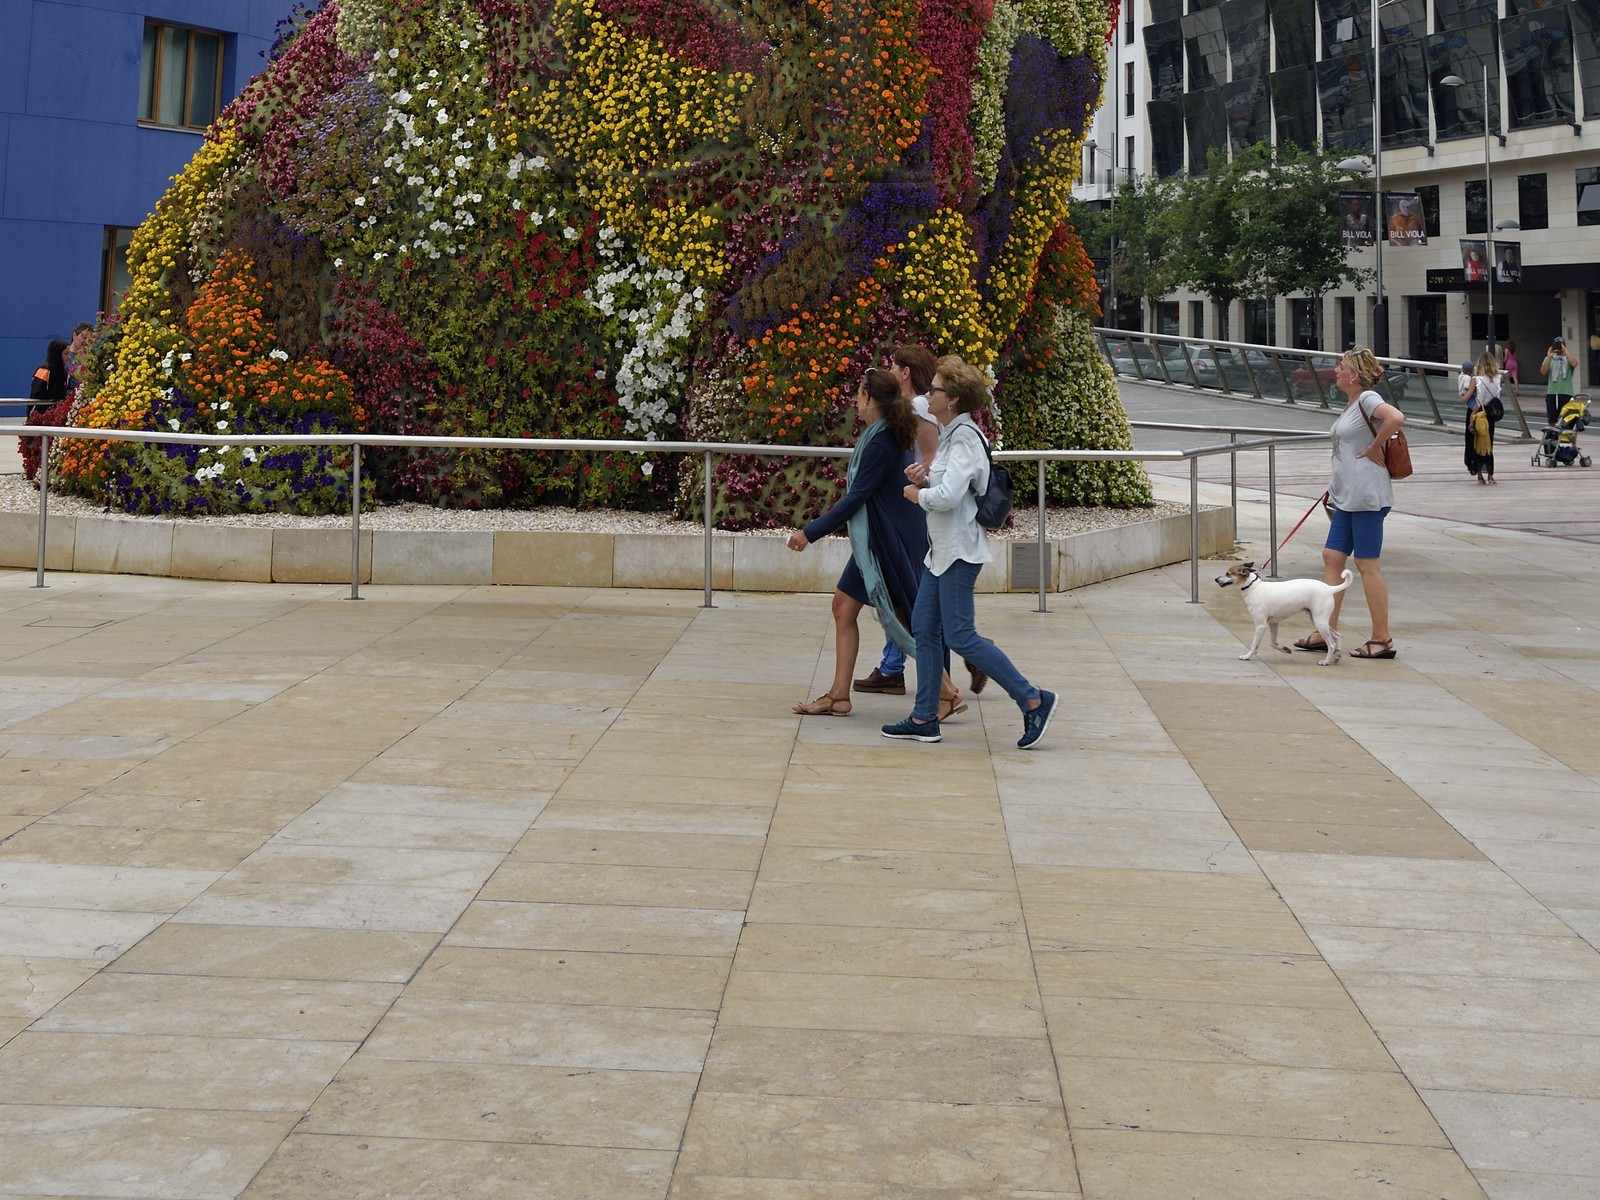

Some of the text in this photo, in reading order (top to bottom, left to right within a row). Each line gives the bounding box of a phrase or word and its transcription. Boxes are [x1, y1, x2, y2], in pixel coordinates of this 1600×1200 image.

[1342, 230, 1372, 239] BILL VIOLA
[1390, 230, 1425, 238] BILL VIOLA
